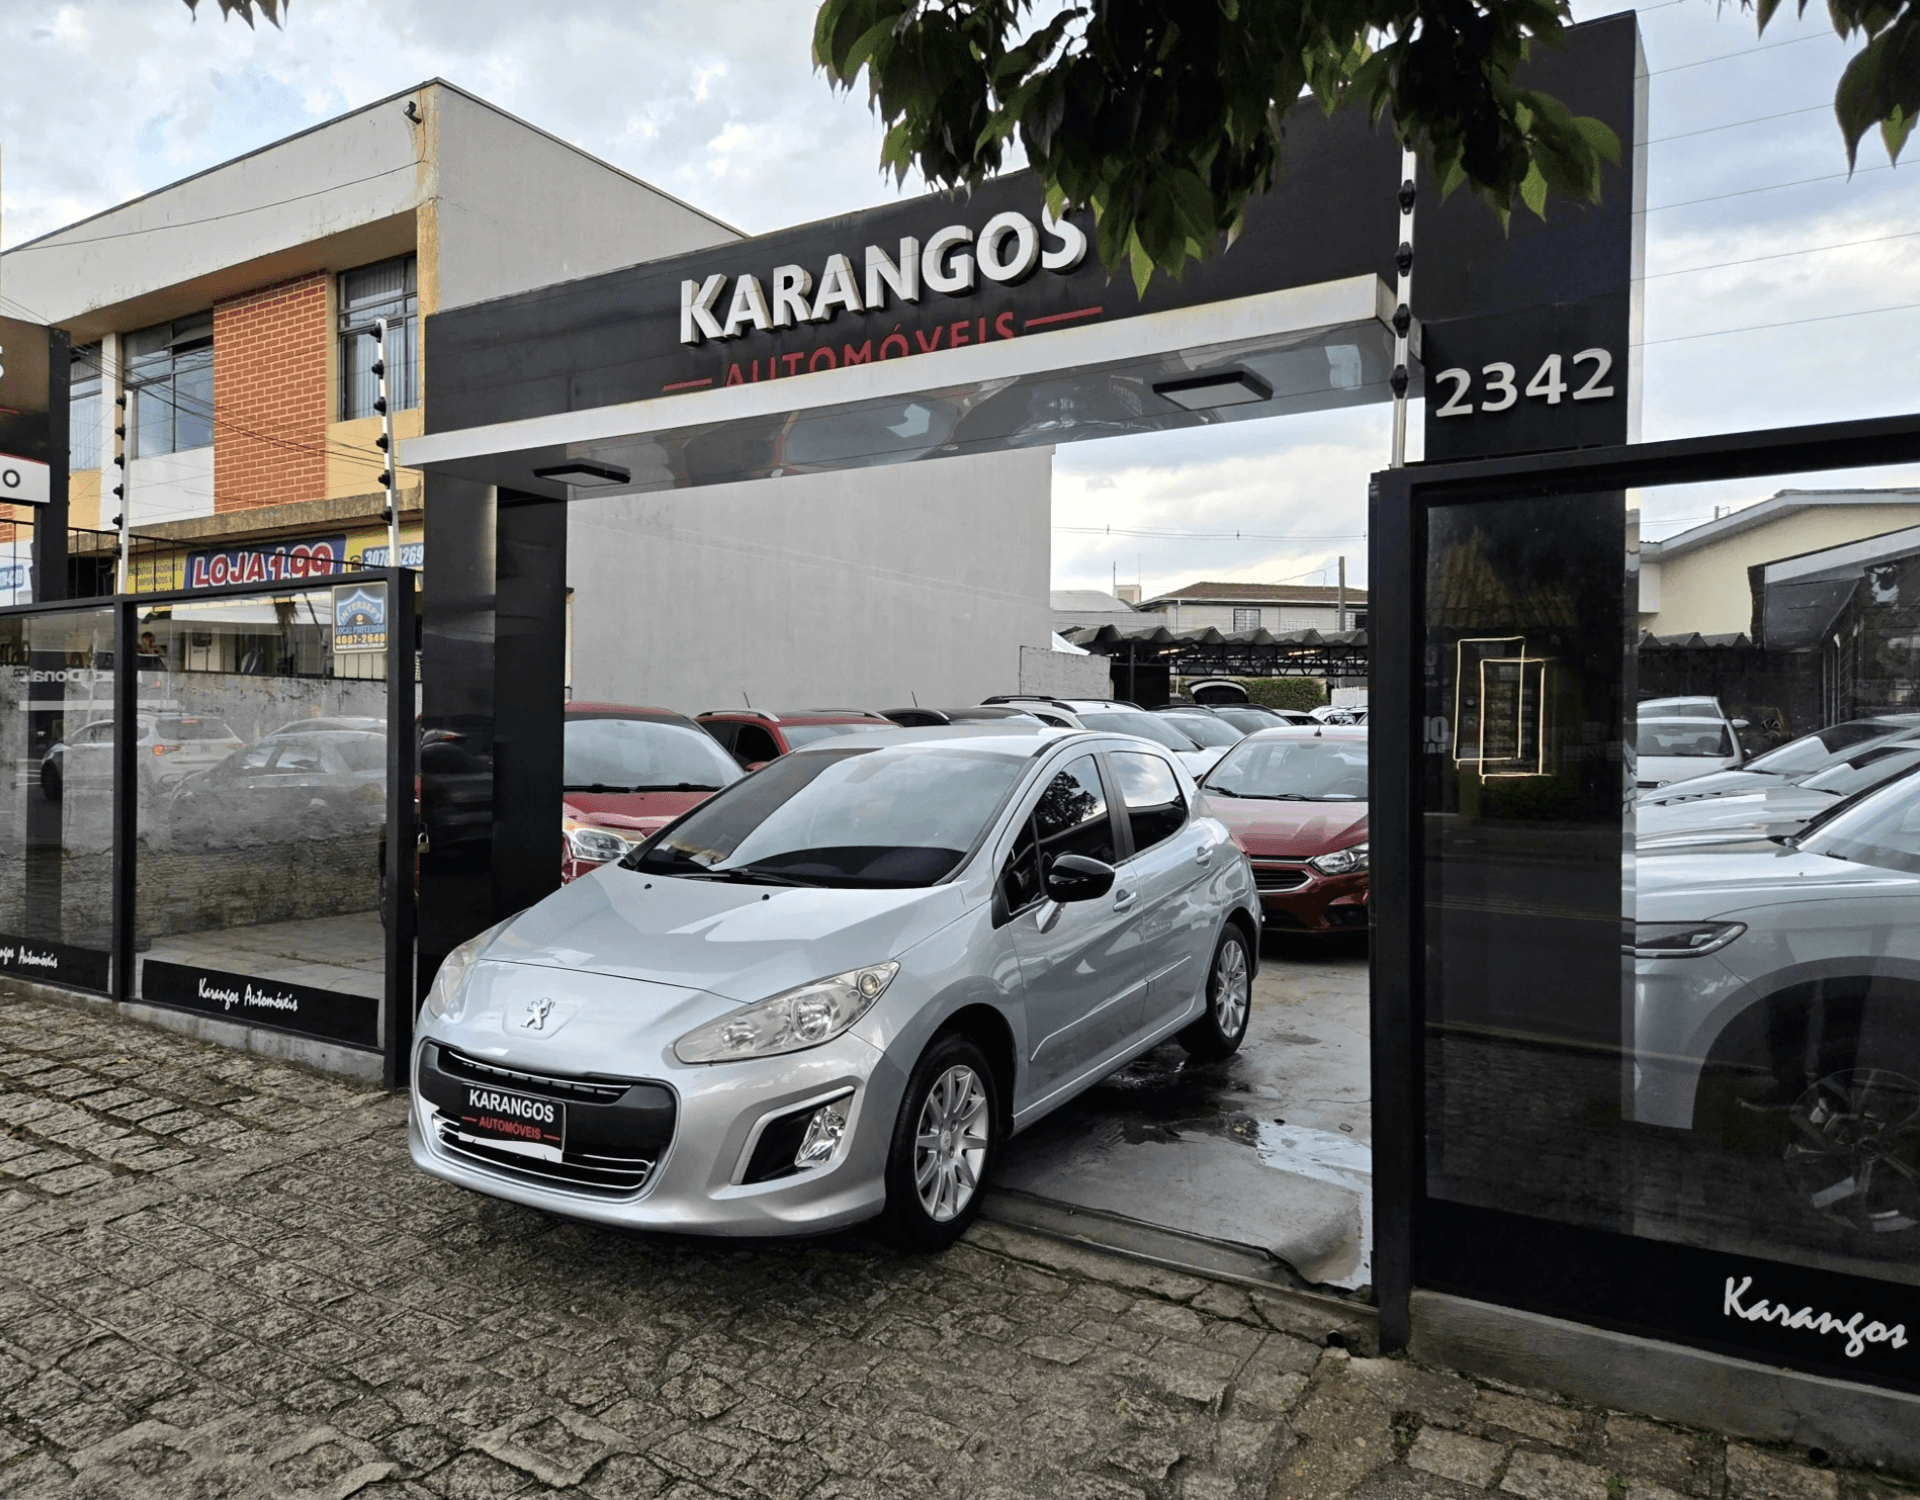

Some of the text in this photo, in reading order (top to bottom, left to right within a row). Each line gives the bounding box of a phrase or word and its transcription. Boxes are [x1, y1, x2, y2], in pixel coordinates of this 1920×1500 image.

[680, 197, 1087, 345] KARANGOS
[1435, 348, 1615, 417] 2342
[192, 542, 334, 589] LOJA 199
[198, 977, 298, 1012] Karangos Automóveis
[469, 1089, 555, 1123] KARANGOS
[478, 1116, 542, 1140] AUTOMÓVEIS
[1723, 1276, 1908, 1357] Karangos
